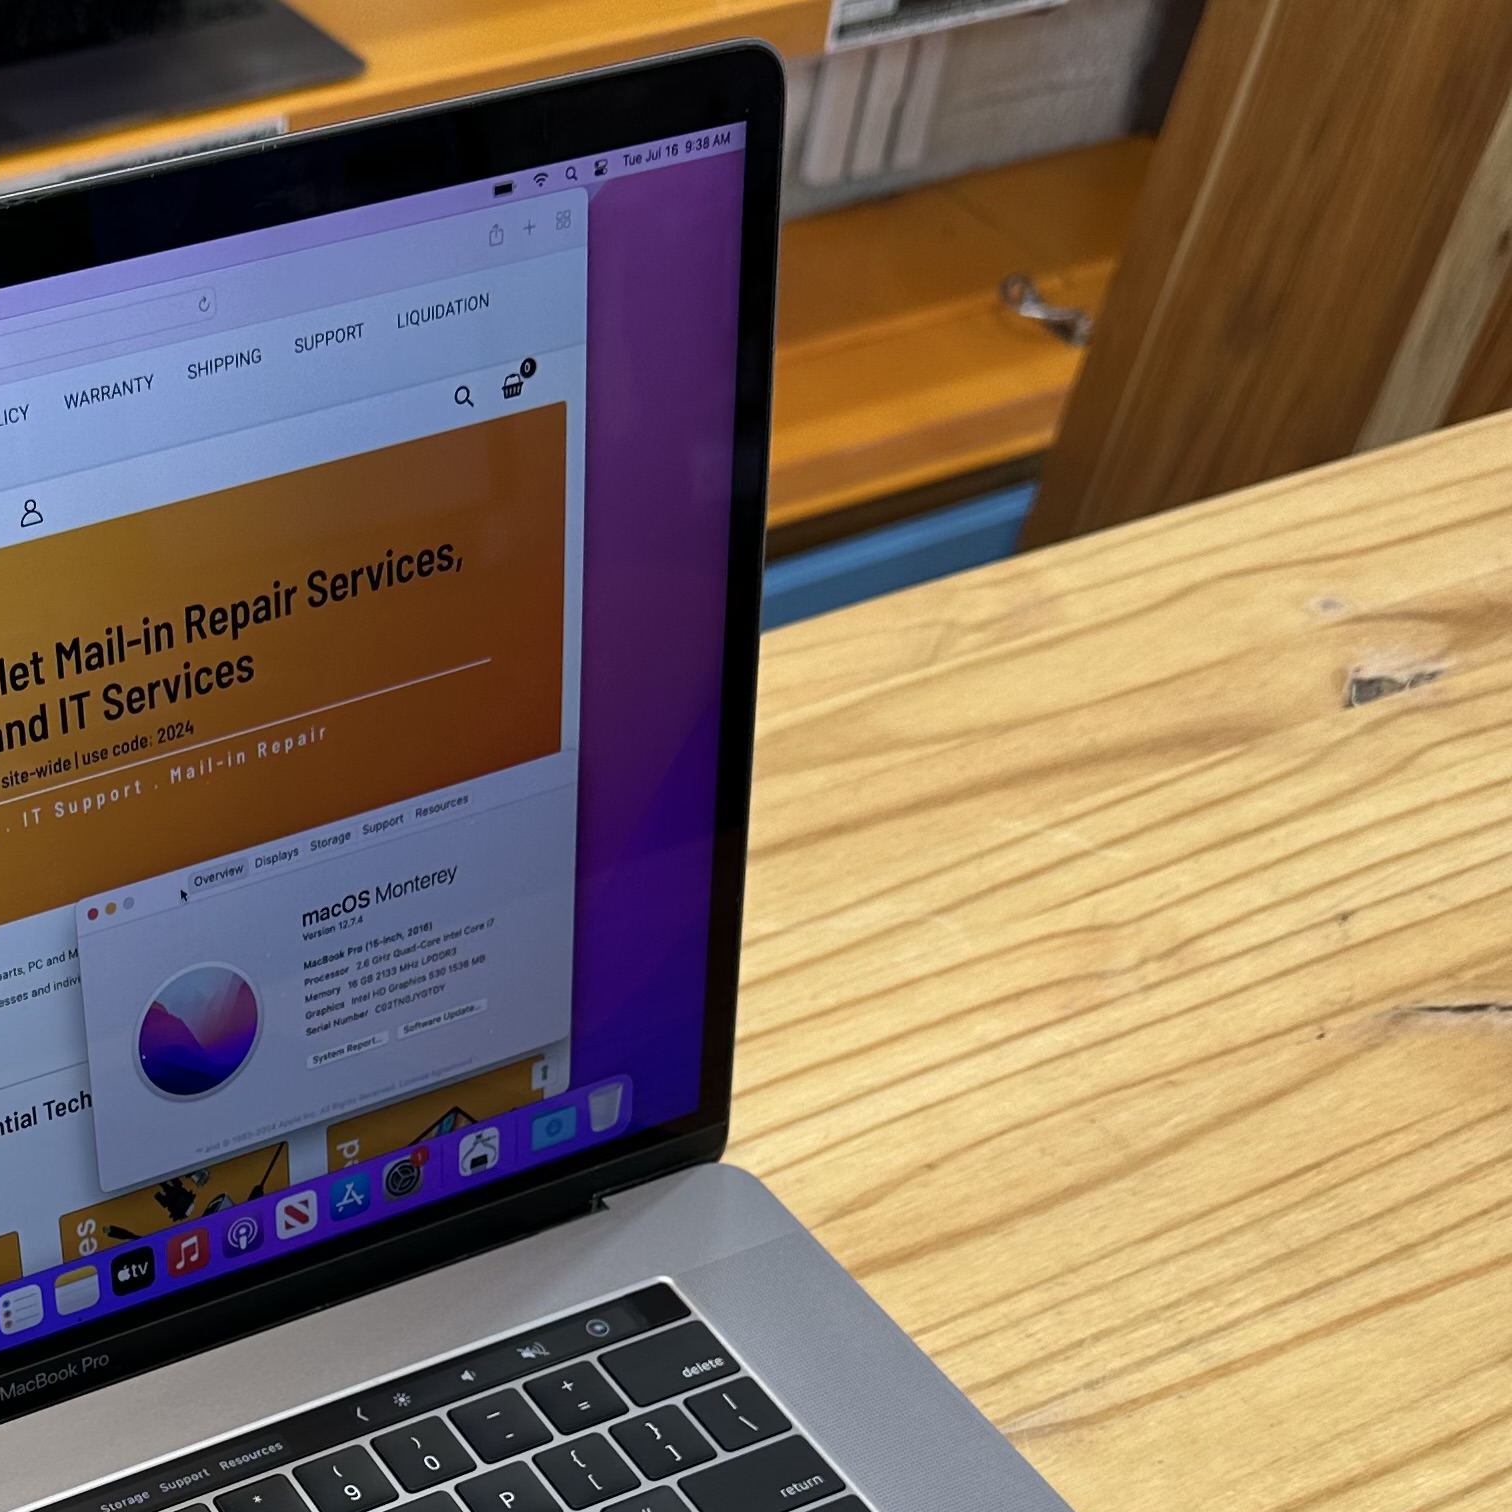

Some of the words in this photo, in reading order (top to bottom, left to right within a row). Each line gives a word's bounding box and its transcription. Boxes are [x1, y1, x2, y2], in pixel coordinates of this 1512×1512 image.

[623, 154, 642, 167] Tue
[646, 147, 661, 163] Jul
[666, 143, 679, 157] 16
[685, 136, 710, 154] 9:38
[712, 131, 731, 147] AM
[64, 374, 153, 409] WARRANTY
[187, 348, 262, 380] SHIPPING
[294, 322, 364, 354] SUPPORT
[398, 293, 489, 329] LIQUIDATION
[521, 362, 531, 378] 0
[55, 617, 174, 679] Mail-in
[185, 581, 297, 643] Repair
[308, 544, 462, 607] Services,
[59, 691, 90, 734] IT
[102, 655, 254, 721] Services
[1, 757, 72, 789] site-wide
[82, 748, 108, 765] use
[157, 720, 194, 744] 2024
[23, 807, 41, 828] IT
[54, 780, 141, 818] Support
[170, 751, 245, 784] Mail-in
[257, 727, 326, 758] Repair
[194, 865, 244, 887] Overview
[255, 848, 299, 869] Displays
[310, 831, 351, 852] Storage
[362, 814, 404, 835] Support
[415, 795, 468, 818] Resources
[302, 890, 371, 927] macOS
[376, 866, 457, 904] Monterey
[28, 959, 43, 972] PC
[46, 952, 65, 967] and
[31, 983, 51, 998] and
[42, 1090, 92, 1120] Tech
[131, 1261, 148, 1278] tv
[0, 1362, 78, 1402] MacBook
[81, 1353, 110, 1374] Pro
[682, 1358, 724, 1378] delete
[159, 1468, 210, 1492] Support
[219, 1443, 283, 1471] Resources
[780, 1475, 824, 1497] return
